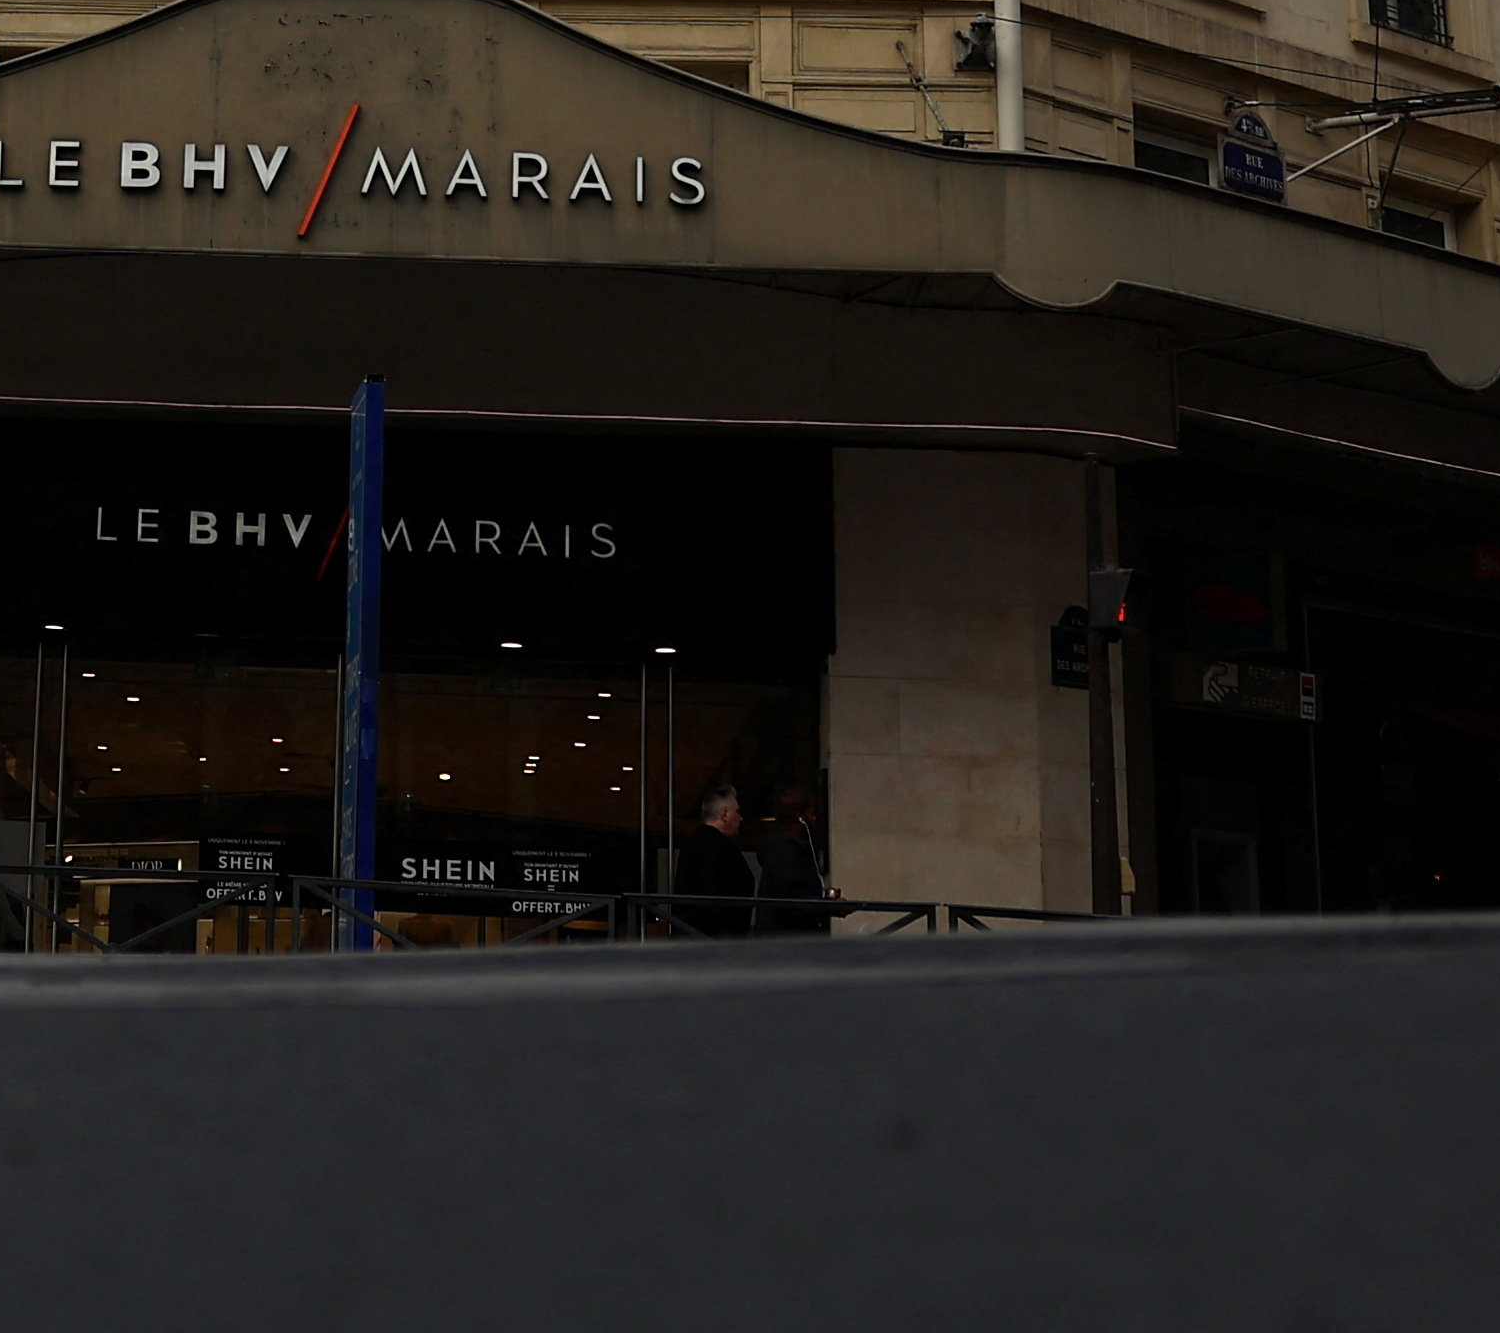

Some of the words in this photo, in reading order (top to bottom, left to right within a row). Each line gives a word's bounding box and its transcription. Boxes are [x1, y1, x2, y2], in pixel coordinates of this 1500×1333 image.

[1245, 153, 1264, 169] RUE
[360, 145, 706, 205] MARAIS
[1224, 165, 1242, 180] DES
[1245, 171, 1285, 191] ARCHIVES
[96, 506, 160, 543] LE
[218, 855, 273, 871] SHEIN
[401, 857, 495, 882] SHEIN
[523, 868, 580, 883] SHEIN
